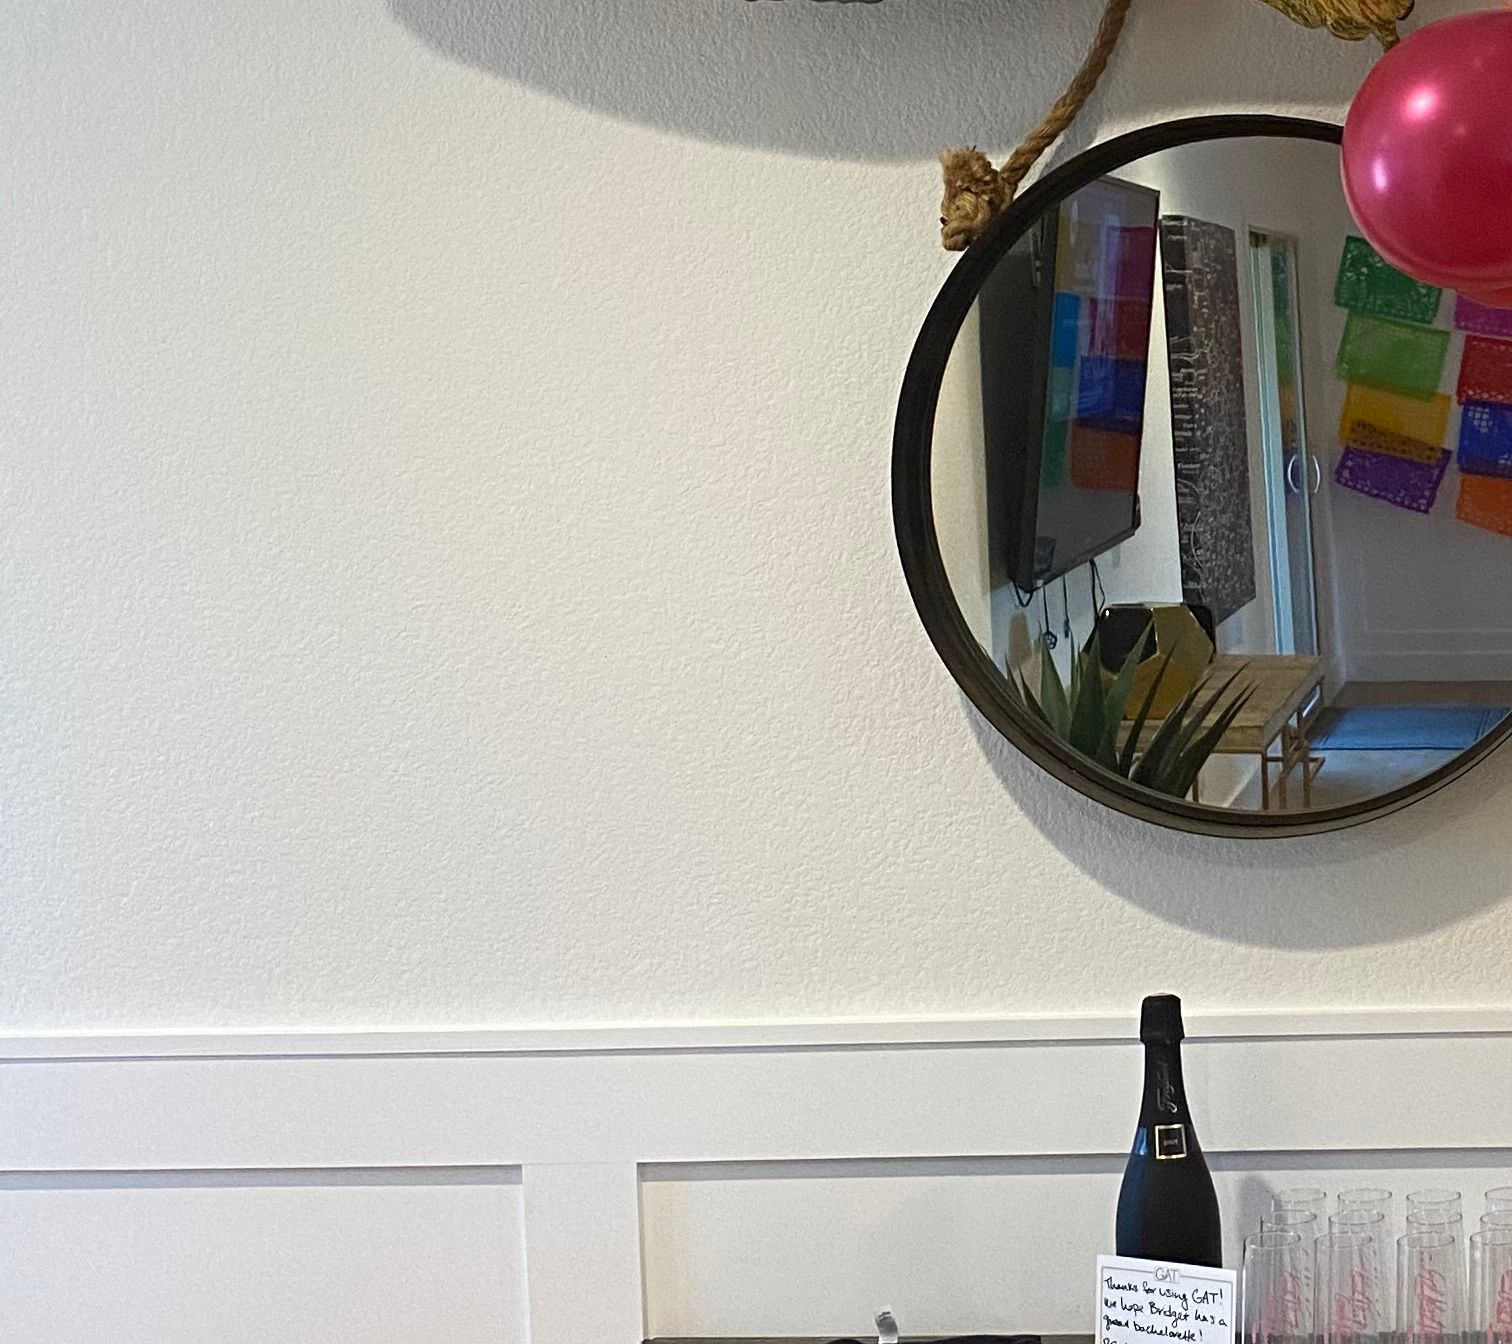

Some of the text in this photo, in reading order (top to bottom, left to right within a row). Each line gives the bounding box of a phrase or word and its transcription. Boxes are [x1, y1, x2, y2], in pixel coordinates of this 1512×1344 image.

[1155, 1267, 1179, 1282] GAT
[1104, 1276, 1223, 1311] Thanks for using GAT!
[1120, 1297, 1144, 1316] hope
[1195, 1309, 1215, 1325] has
[1218, 1319, 1228, 1327] a
